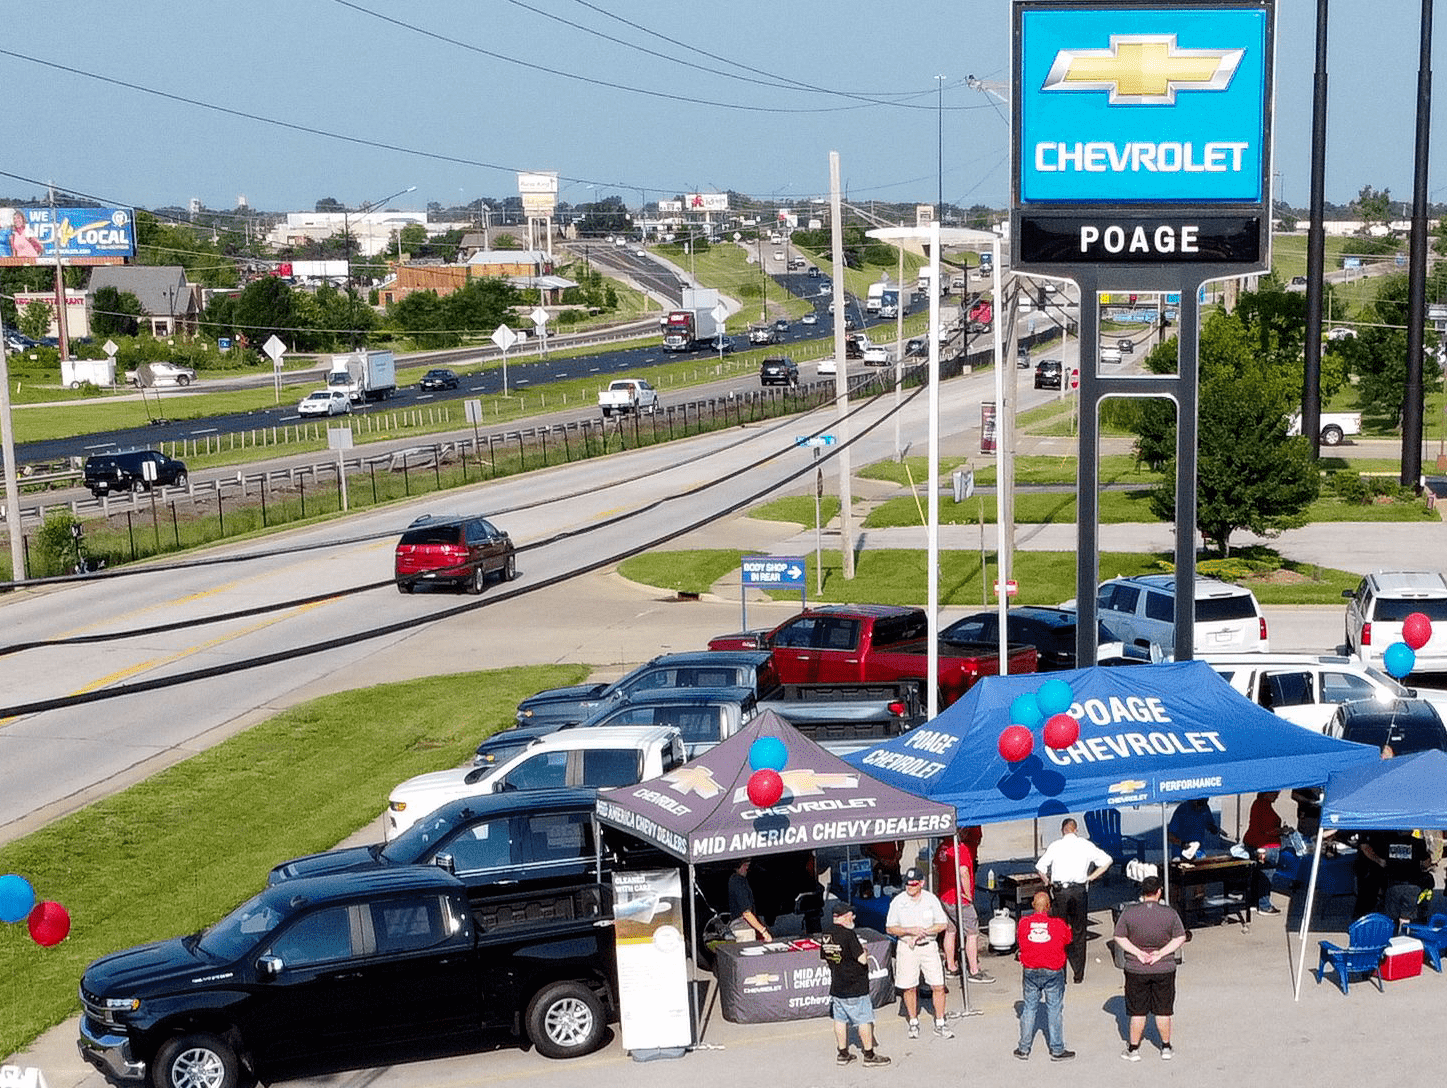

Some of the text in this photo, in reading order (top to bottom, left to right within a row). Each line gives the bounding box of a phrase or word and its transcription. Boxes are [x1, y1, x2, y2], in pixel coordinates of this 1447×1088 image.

[1035, 141, 1249, 172] CHEVROLET
[29, 211, 49, 222] WE
[77, 229, 129, 245] LOCAL
[1080, 226, 1200, 253] POAGE
[743, 562, 788, 572] BODY SHOP
[750, 572, 781, 582] IN REAR
[904, 730, 959, 755] POAGE
[1045, 731, 1227, 766] CHEVROLET
[862, 749, 946, 779] CHEVROLET
[1159, 776, 1222, 792] PERFORMANCE
[632, 787, 692, 817] CHEVROLET
[1107, 794, 1148, 805] CHEVROLET
[740, 797, 877, 821] CHEVROLET
[607, 803, 635, 829] AMERICA
[635, 814, 658, 839] CHEVY
[656, 825, 688, 856] DEALERS
[692, 814, 952, 857] MID AMERICA CHEVY DEALERS
[615, 884, 634, 893] WITH
[793, 968, 814, 981] MID
[743, 984, 783, 994] CHEVROLET
[793, 977, 821, 990] CHEVY
